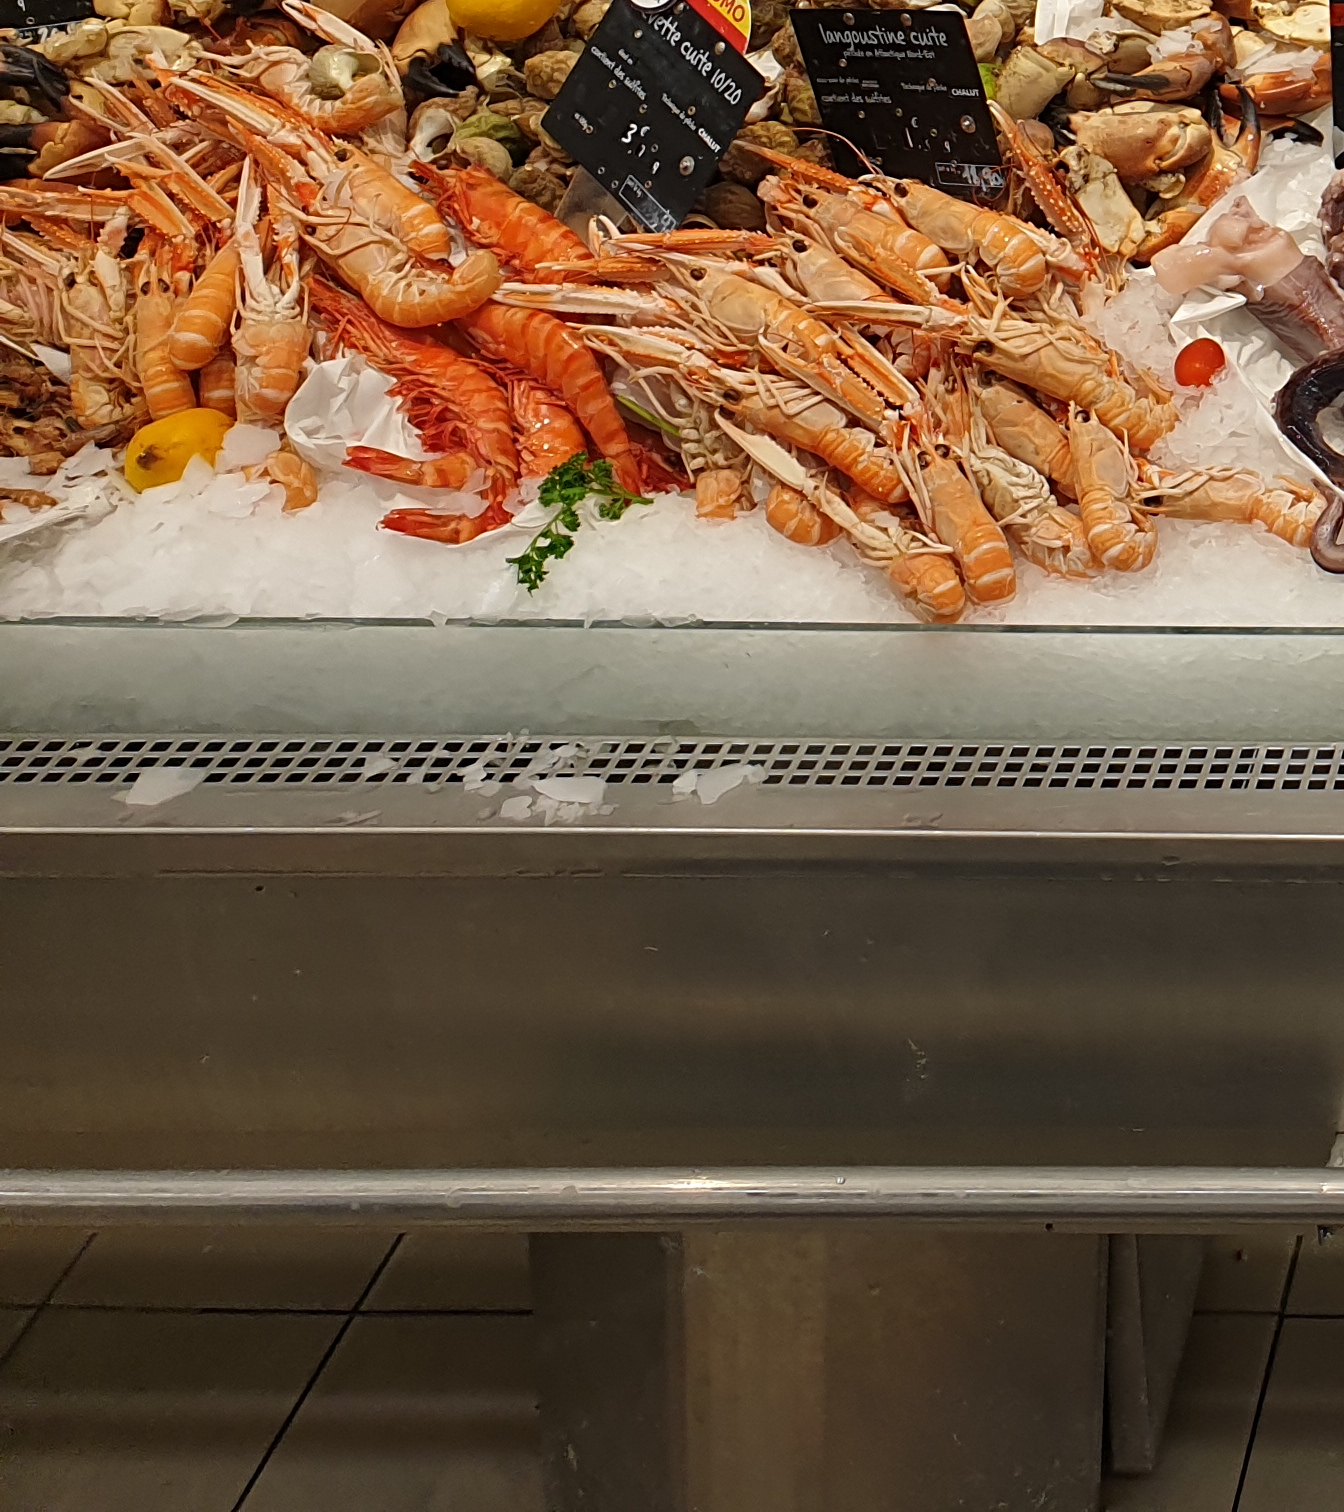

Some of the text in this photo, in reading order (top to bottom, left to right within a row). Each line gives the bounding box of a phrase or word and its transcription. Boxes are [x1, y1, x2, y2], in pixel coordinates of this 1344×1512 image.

[818, 23, 949, 50] langoustine cuite
[641, 11, 743, 105] vette cuite 10/20
[697, 127, 722, 154] CHALUT
